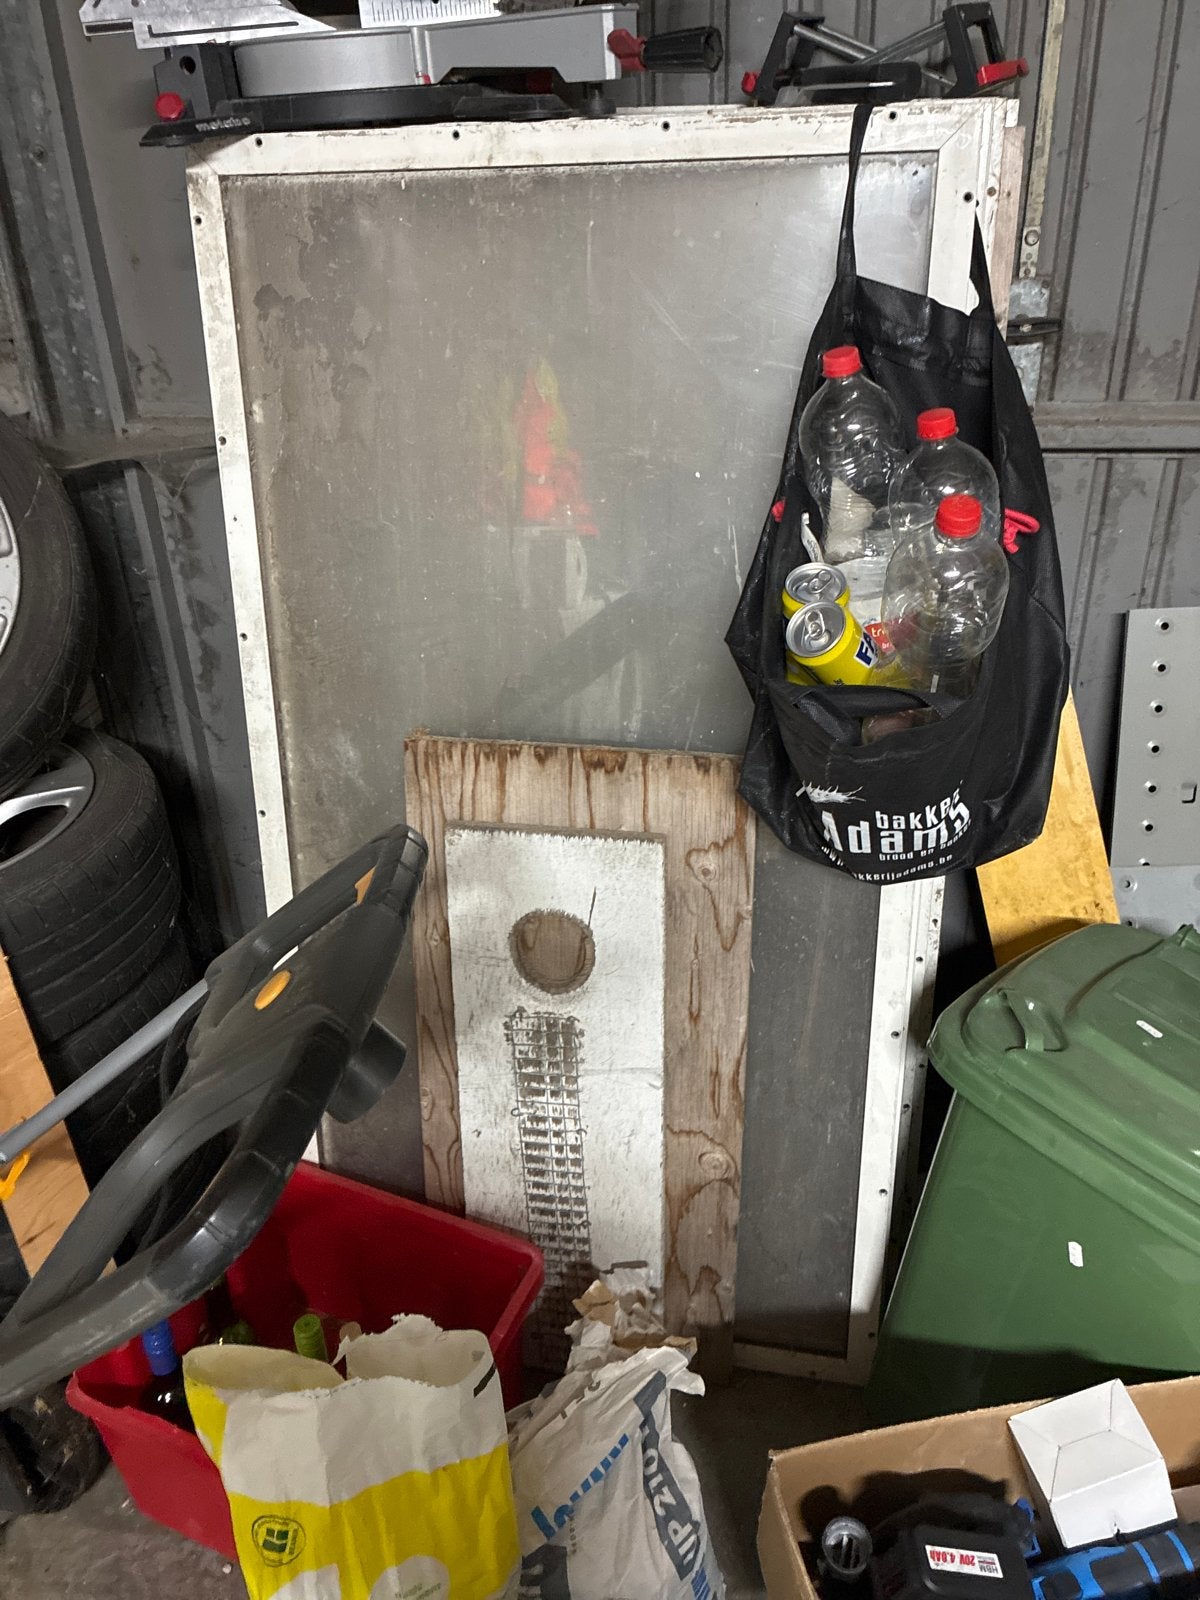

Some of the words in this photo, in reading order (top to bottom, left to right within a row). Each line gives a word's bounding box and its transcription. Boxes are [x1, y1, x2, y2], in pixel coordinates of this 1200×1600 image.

[879, 851, 914, 861] brood
[920, 848, 934, 857] en
[929, 1550, 956, 1563] 4.0Ah
[959, 1553, 976, 1566] 20V
